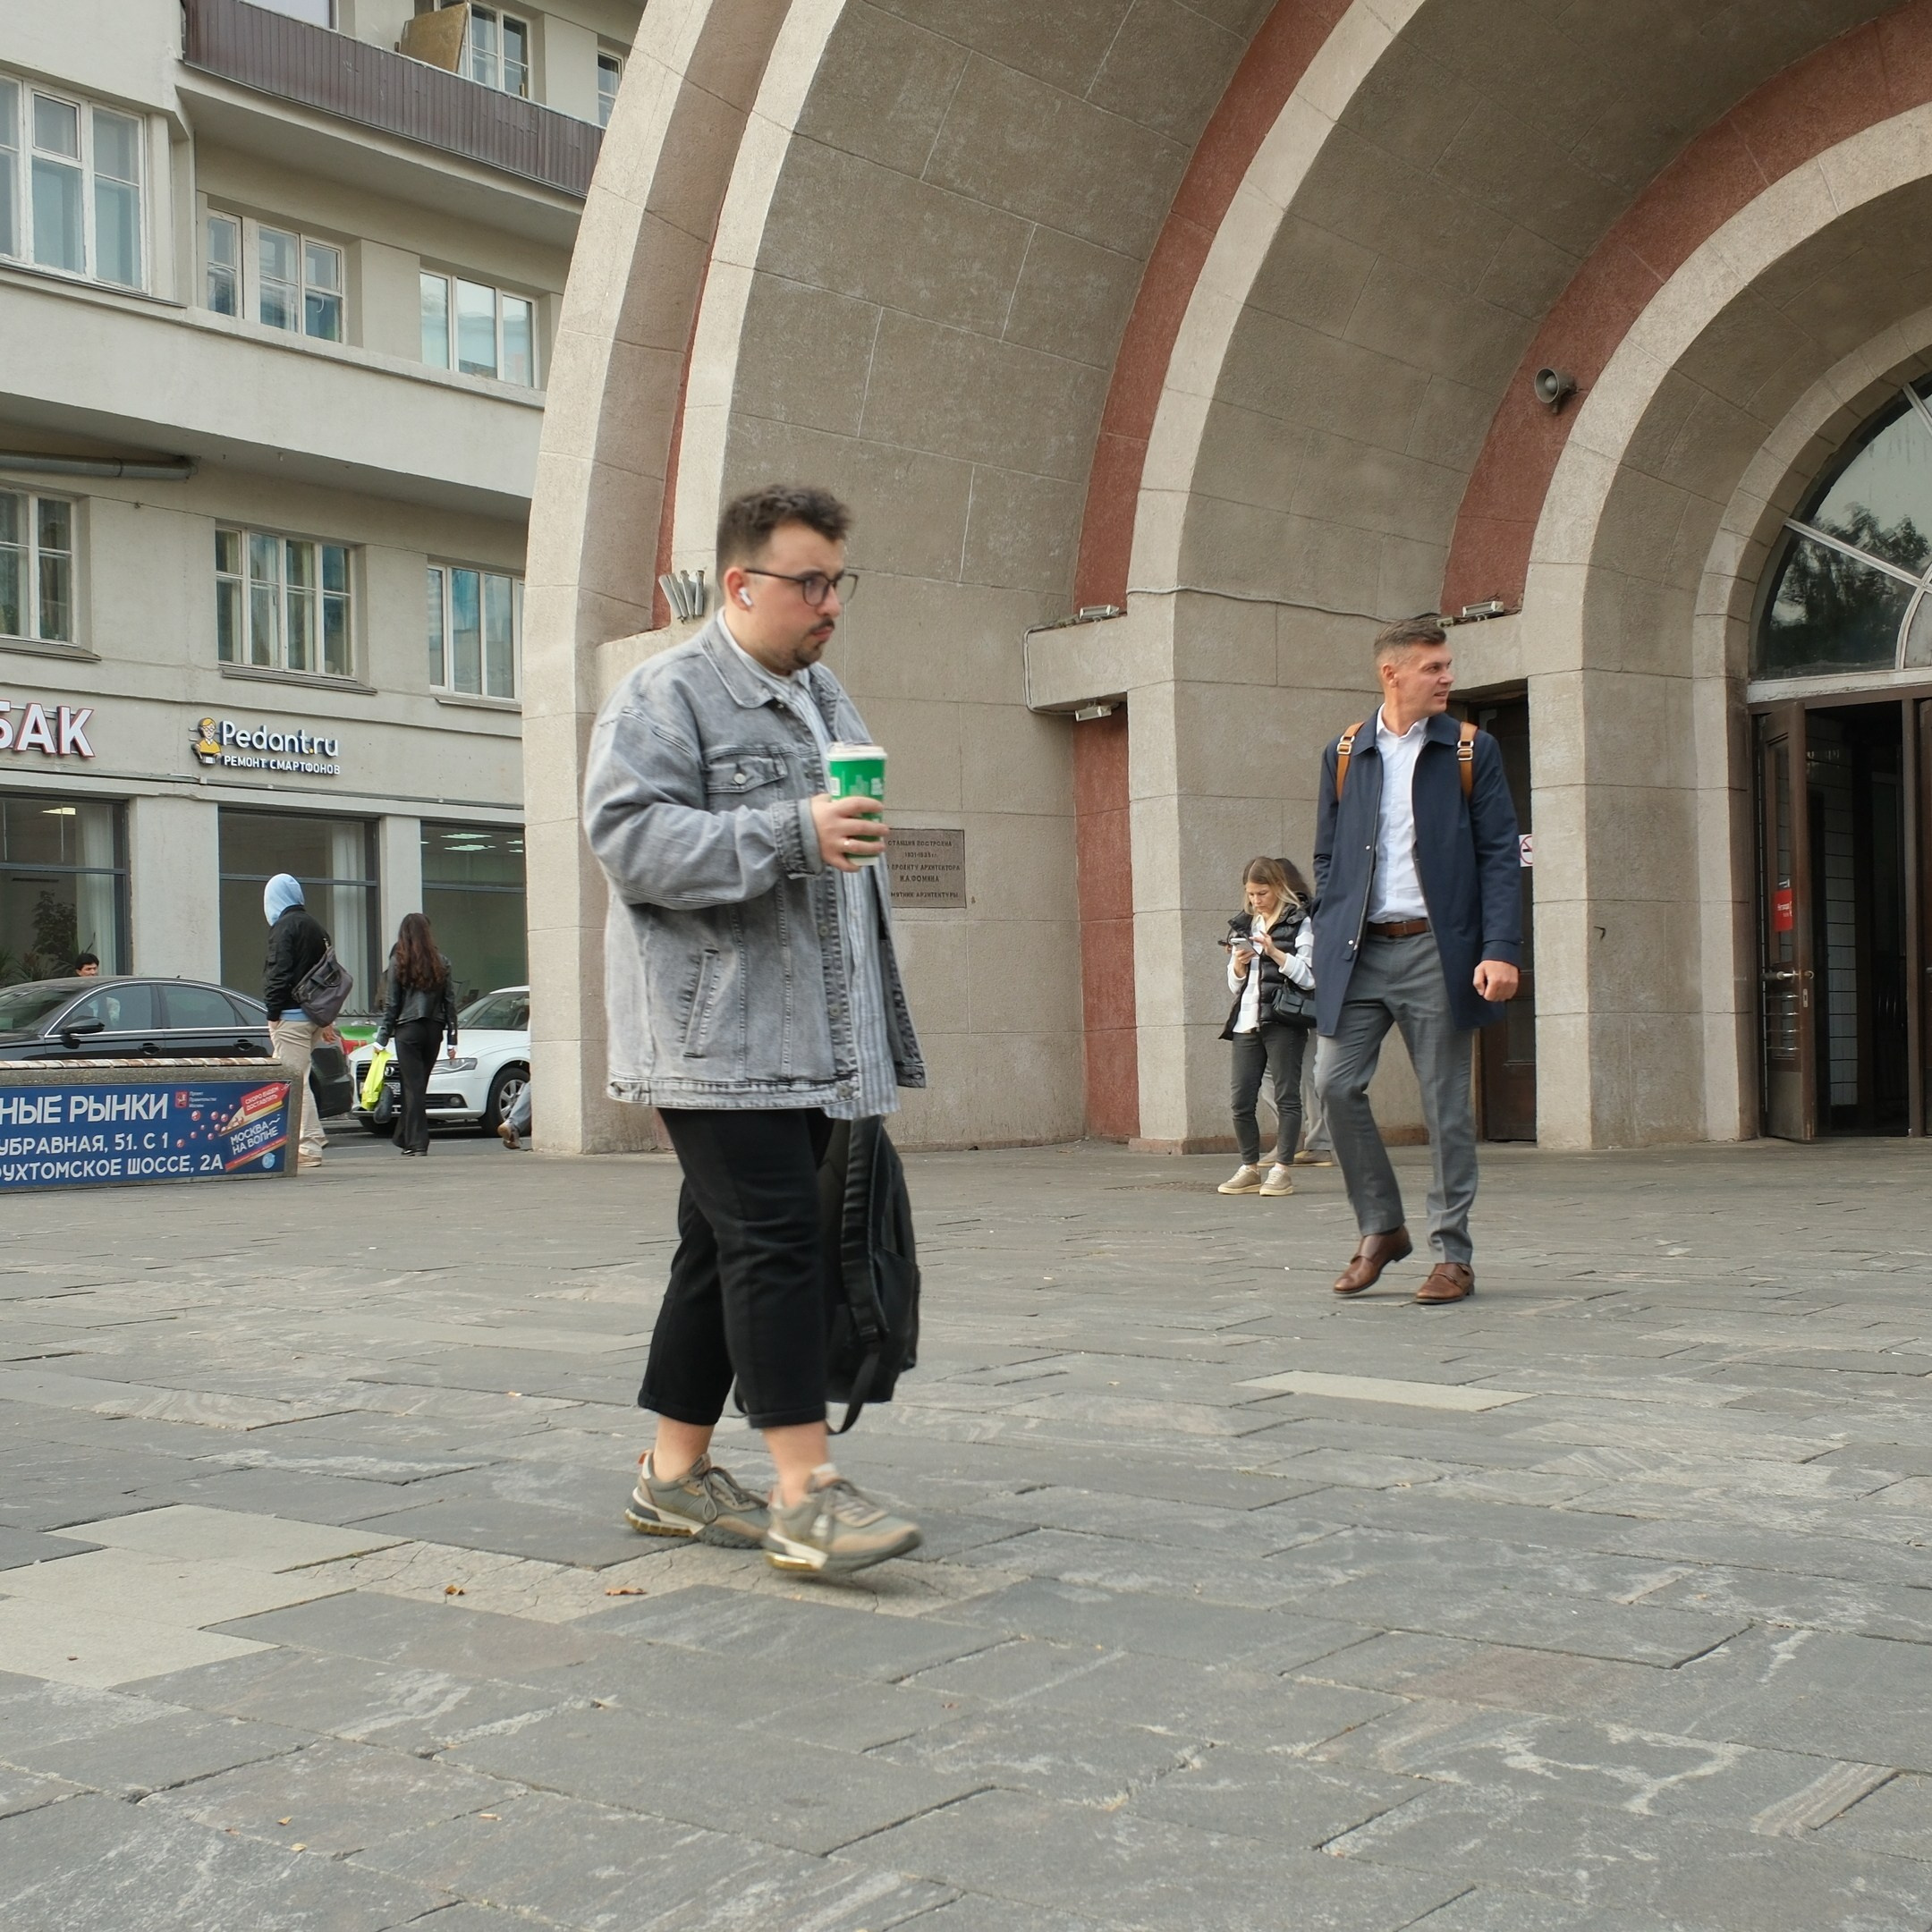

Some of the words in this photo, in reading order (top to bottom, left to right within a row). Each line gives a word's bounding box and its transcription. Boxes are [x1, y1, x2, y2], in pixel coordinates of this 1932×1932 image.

[220, 720, 339, 757] Pedant.ru
[223, 755, 267, 768] РЕМОНТ
[269, 758, 341, 775] СМАРТФОНОВ
[0, 1095, 63, 1124] НЫЕ
[69, 1093, 169, 1123] РЫНКИ
[143, 1132, 157, 1149] С
[162, 1131, 168, 1148] 1
[230, 1121, 269, 1146] МОСКВА
[232, 1141, 248, 1156] НА
[247, 1126, 279, 1148] ВОЛНЕ
[0, 1157, 123, 1182] УХТОМСКОЕ
[127, 1154, 195, 1175] ШОССЕ,
[199, 1153, 224, 1171] 2А
